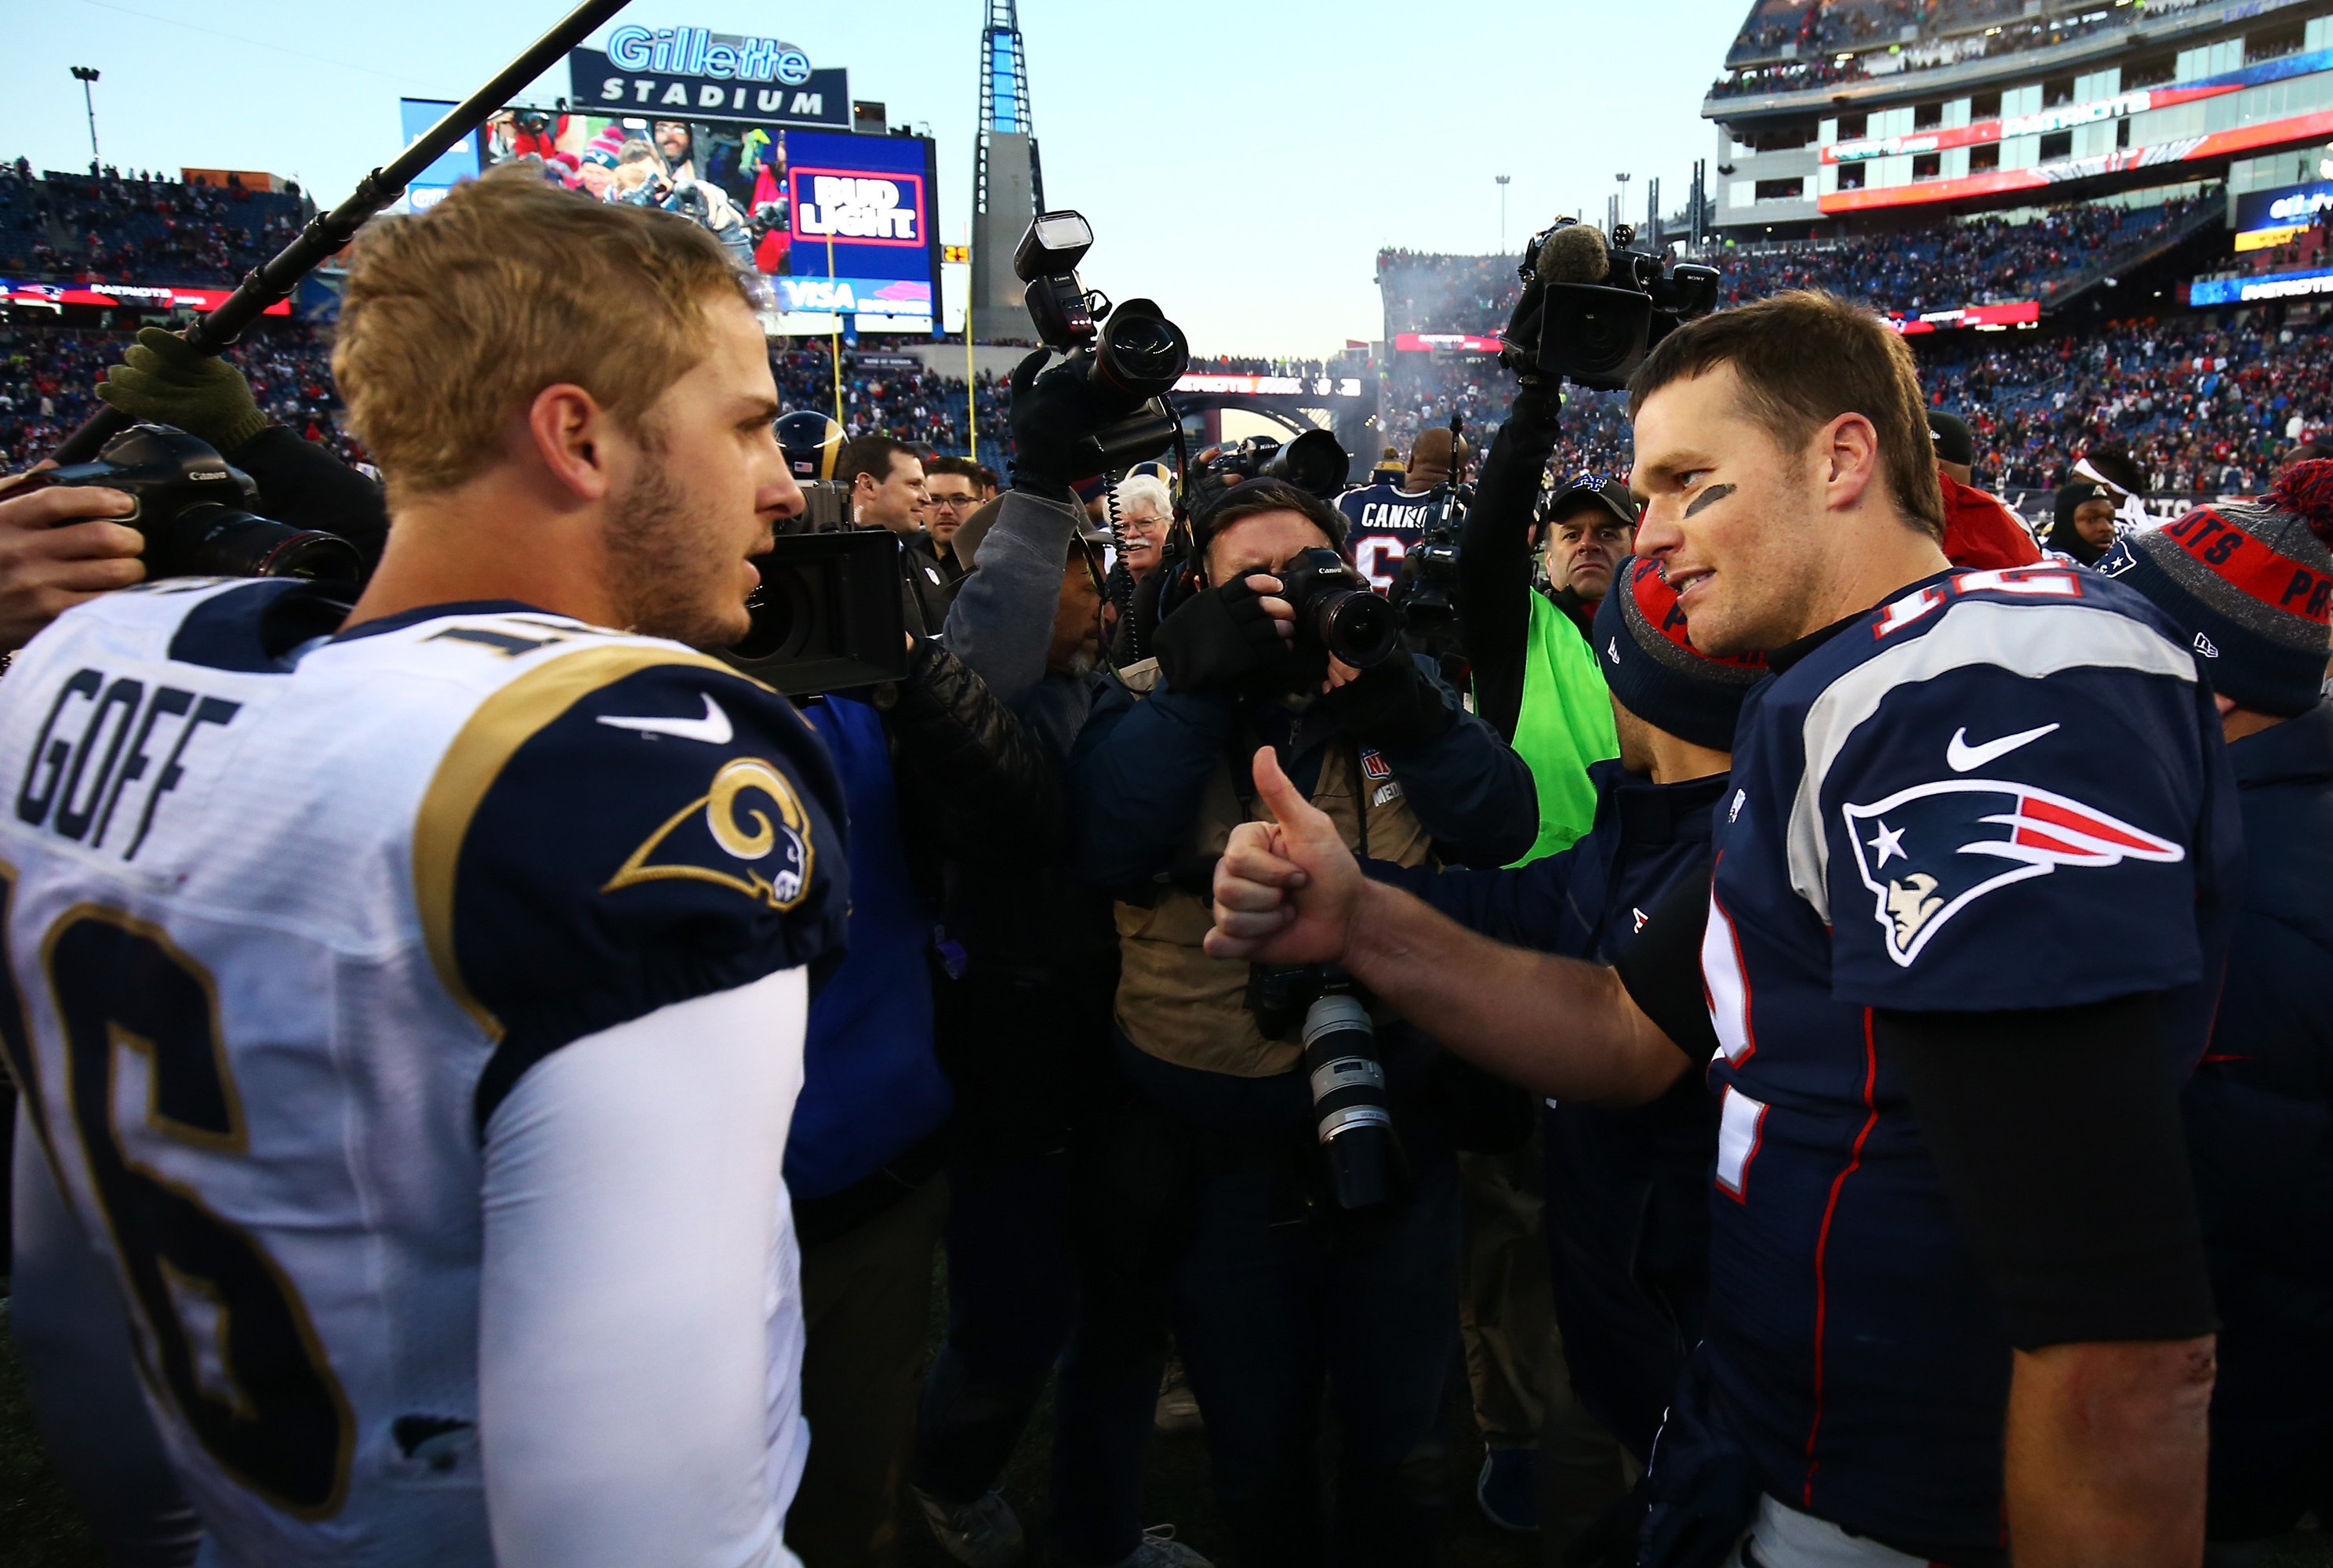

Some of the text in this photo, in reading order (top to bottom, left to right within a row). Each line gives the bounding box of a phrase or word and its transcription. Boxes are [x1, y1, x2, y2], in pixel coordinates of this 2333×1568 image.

[607, 24, 812, 85] Gillette
[601, 78, 823, 115] STADIUM
[2001, 91, 2151, 139] PATRIOTS
[814, 176, 899, 208] BUD
[90, 283, 173, 298] PATRIOTS
[783, 280, 856, 309] VISA
[188, 472, 227, 481] Canon
[16, 668, 244, 862] GOFF
